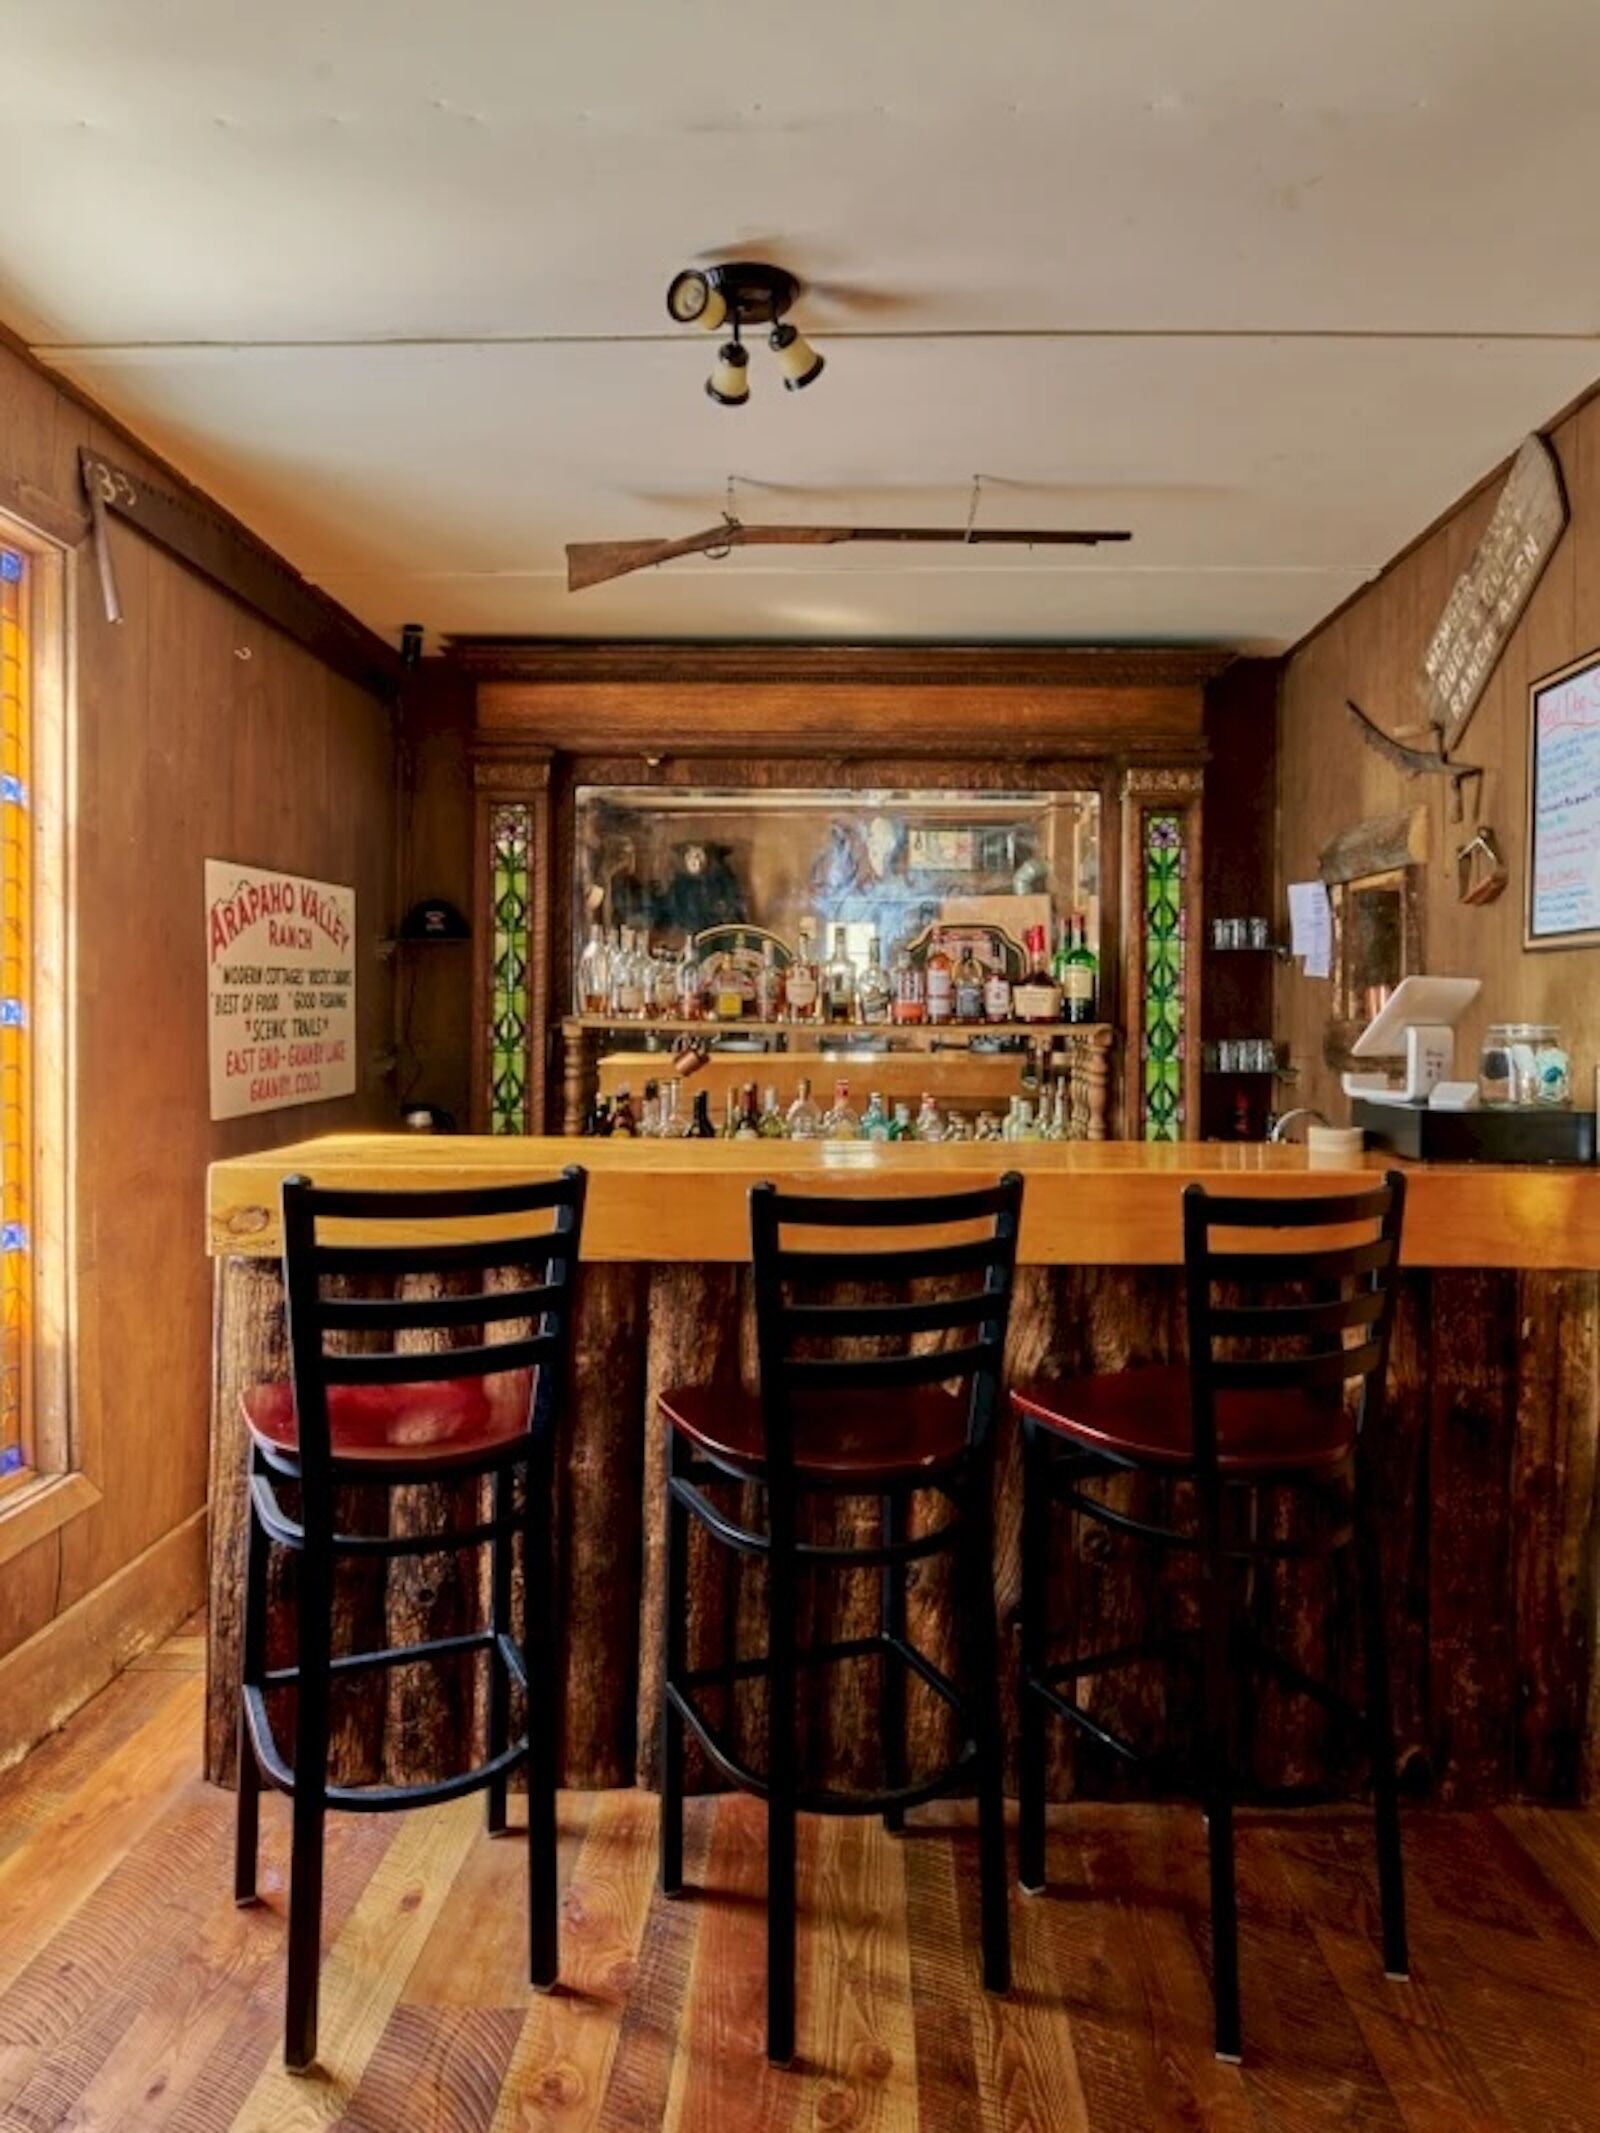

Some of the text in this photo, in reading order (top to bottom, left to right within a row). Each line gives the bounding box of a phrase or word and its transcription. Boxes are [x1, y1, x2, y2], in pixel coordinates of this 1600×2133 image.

[1450, 623, 1496, 720] RANCH
[211, 882, 350, 962] ARAPAHO VALLEY
[268, 919, 312, 949] RANCH
[256, 993, 279, 1012] FOOD
[226, 1048, 256, 1077] EAST
[259, 1045, 279, 1071] END
